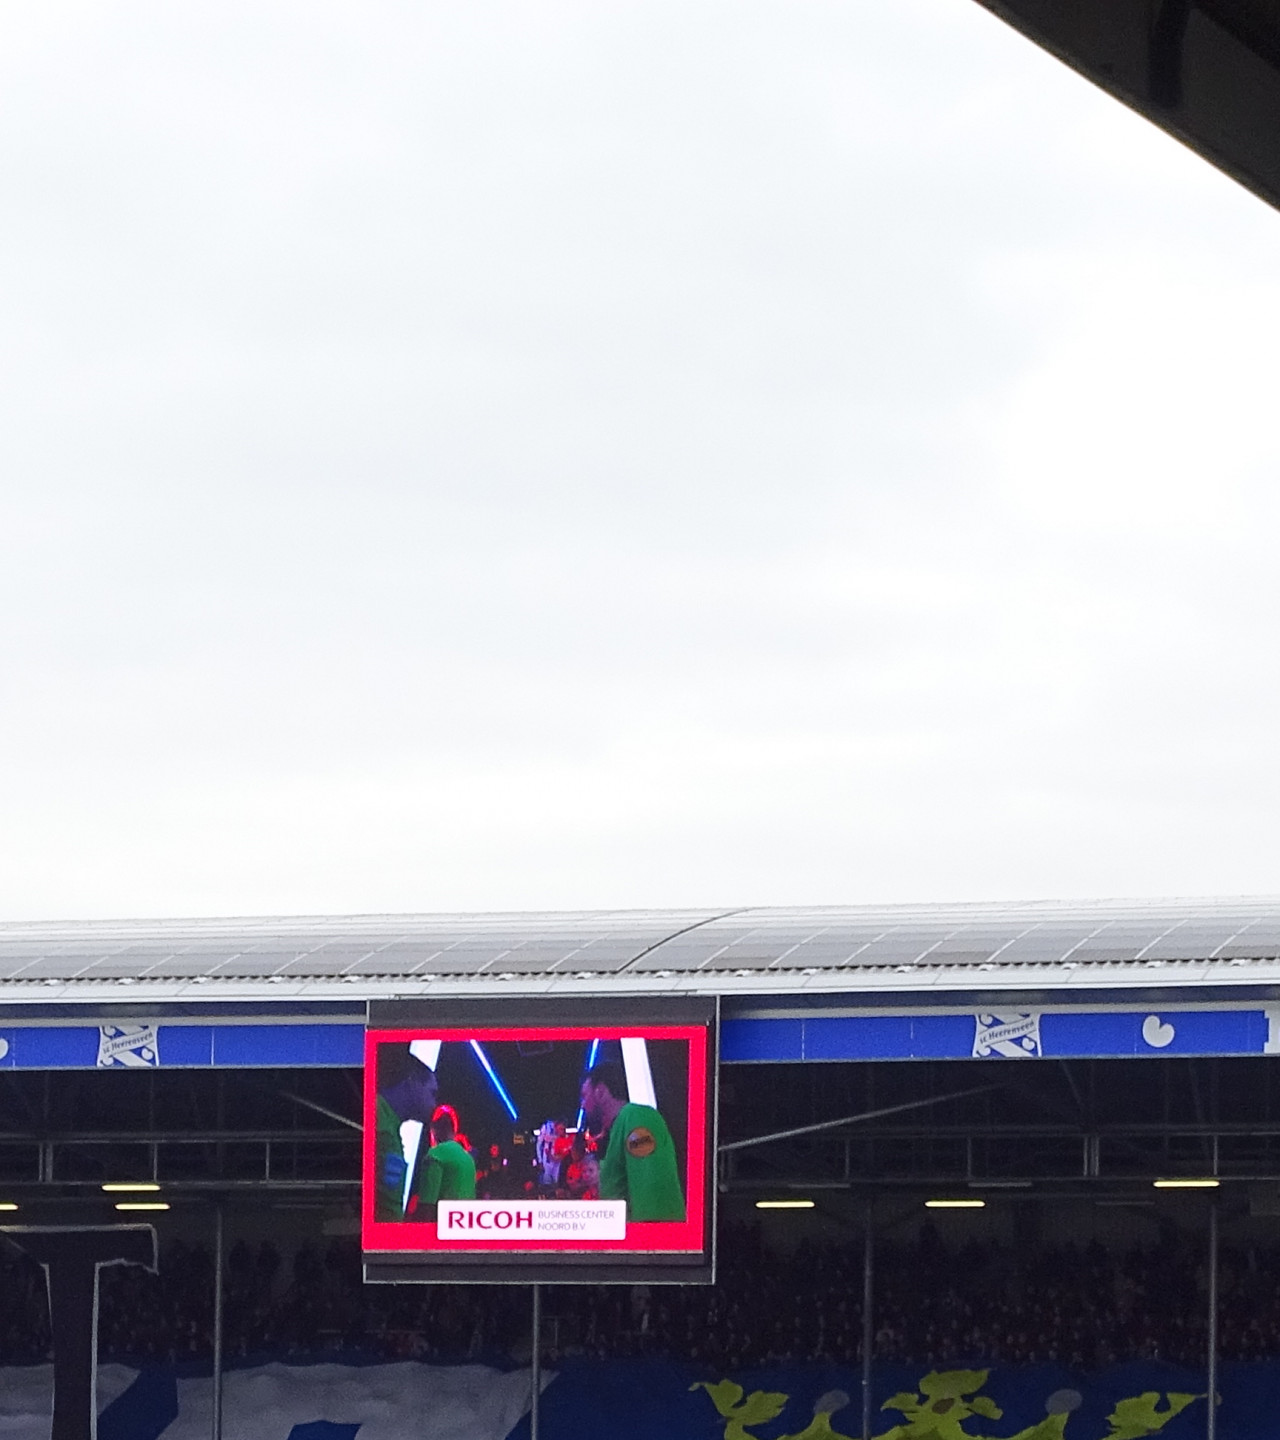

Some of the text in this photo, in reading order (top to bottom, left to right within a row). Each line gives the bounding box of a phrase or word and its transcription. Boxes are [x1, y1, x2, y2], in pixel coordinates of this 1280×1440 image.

[448, 1210, 615, 1229] RICOH BUSINESS CENTER
[537, 1223, 571, 1231] NOORD
